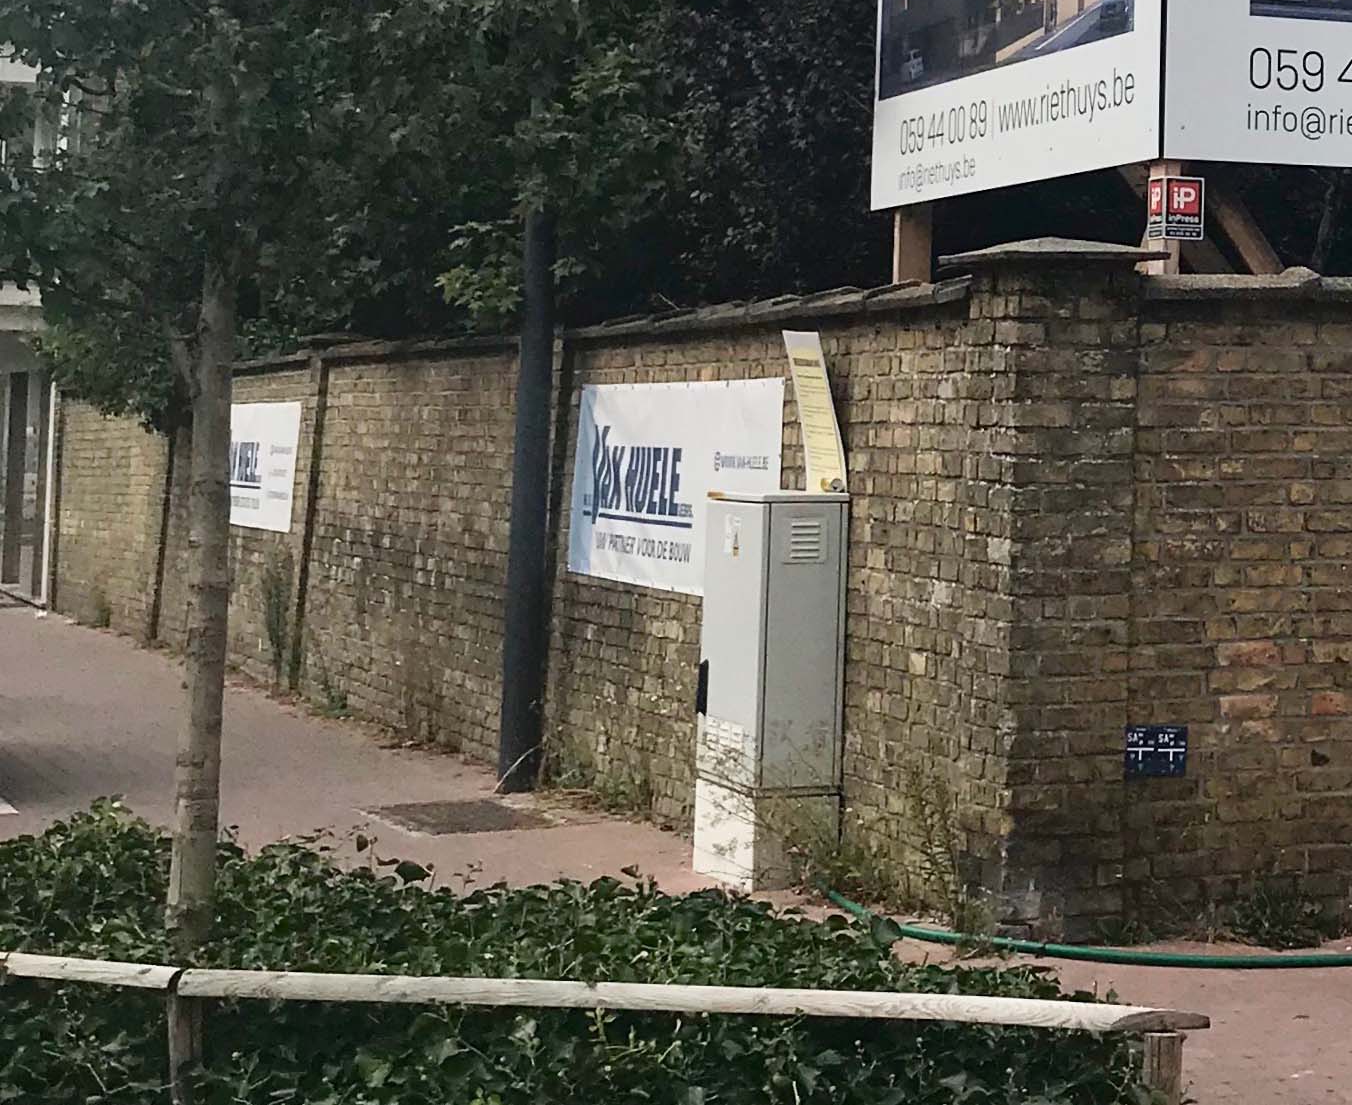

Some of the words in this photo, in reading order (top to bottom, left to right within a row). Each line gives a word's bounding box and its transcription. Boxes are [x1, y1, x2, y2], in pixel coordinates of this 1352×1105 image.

[1248, 47, 1324, 92] 059
[900, 116, 925, 156] 059
[927, 111, 945, 148] 44
[949, 105, 966, 144] 00
[969, 99, 988, 140] 89
[999, 68, 1136, 133] www.riethuys.be
[624, 446, 682, 517] HUELE
